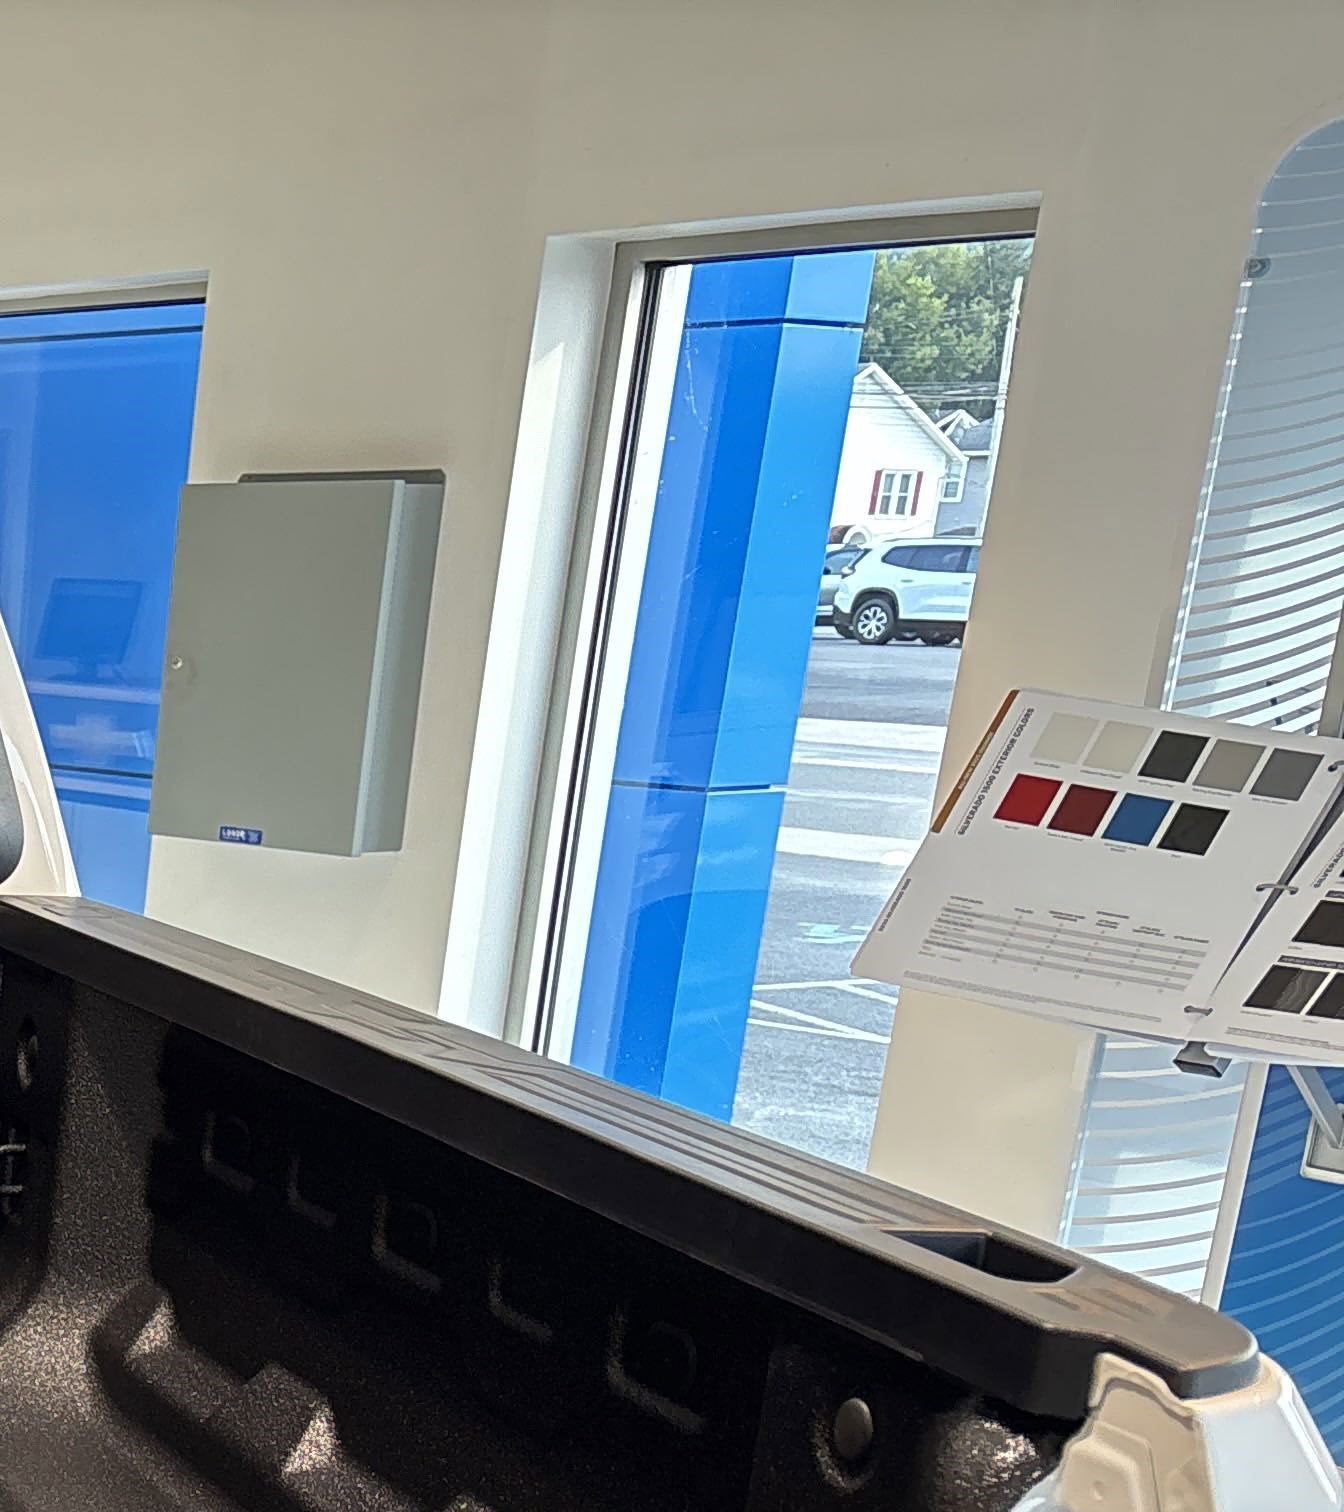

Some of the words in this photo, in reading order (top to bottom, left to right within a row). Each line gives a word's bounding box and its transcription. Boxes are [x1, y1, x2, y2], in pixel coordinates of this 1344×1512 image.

[958, 794, 985, 836] SILVERADO
[981, 774, 997, 795] 1500
[992, 737, 1017, 777] EXTERIOR
[1015, 707, 1035, 739] COLORS
